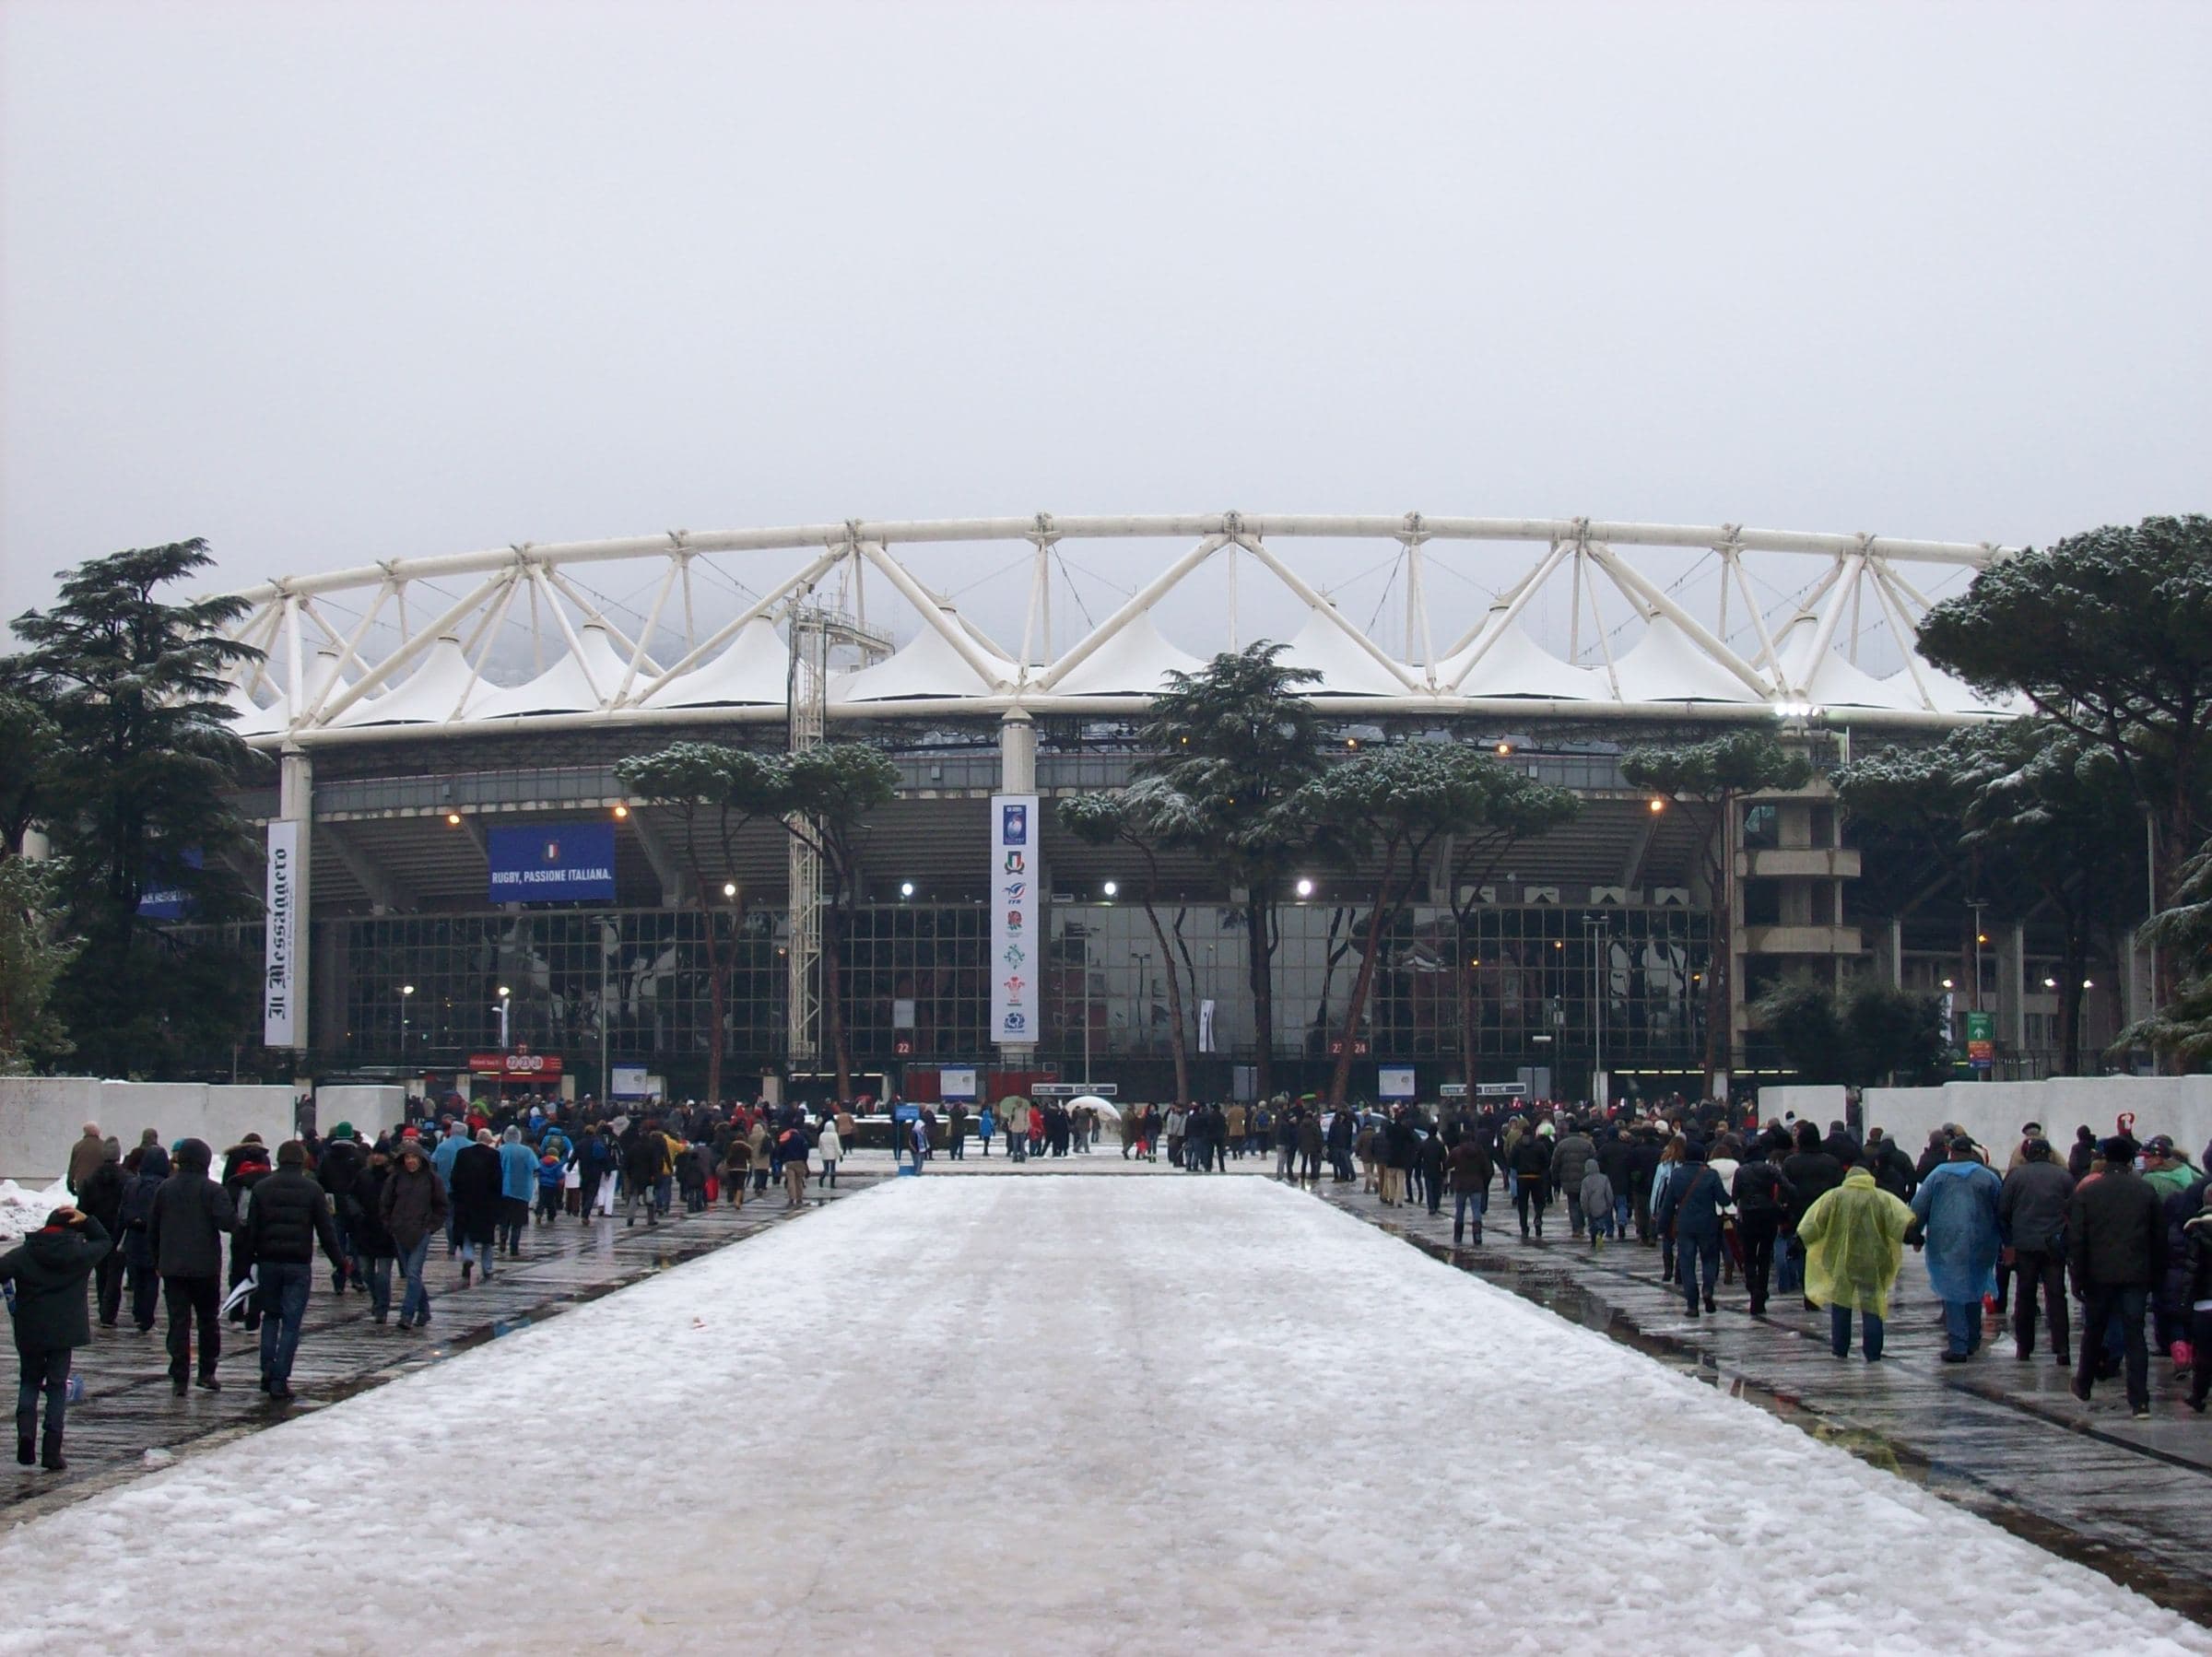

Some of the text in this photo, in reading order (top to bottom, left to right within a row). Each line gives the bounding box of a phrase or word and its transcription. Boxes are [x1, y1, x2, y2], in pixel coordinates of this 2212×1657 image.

[492, 868, 612, 885] RUGBY, PASSIONE ITALIANA.
[269, 848, 289, 990] Messaggero
[898, 1043, 910, 1053] 22
[1354, 1043, 1366, 1053] 24
